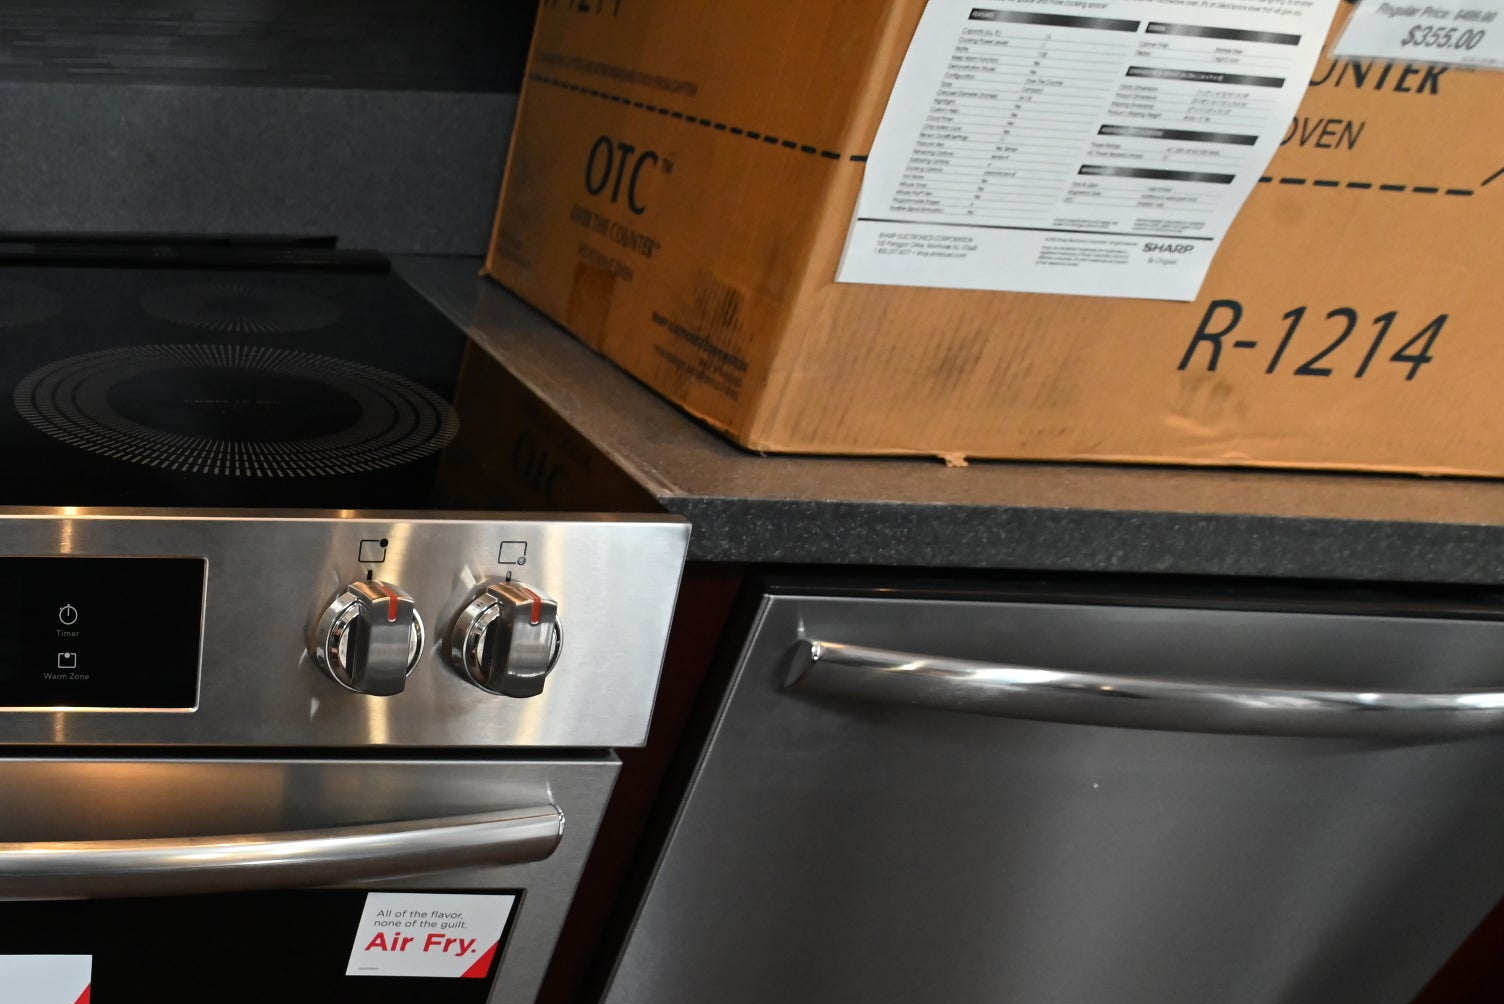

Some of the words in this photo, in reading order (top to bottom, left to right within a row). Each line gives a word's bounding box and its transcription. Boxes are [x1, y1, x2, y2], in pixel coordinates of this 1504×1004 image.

[1376, 2, 1419, 18] Regular
[1401, 24, 1486, 51] $355.00
[1142, 242, 1194, 254] SHARP
[1177, 298, 1450, 381] R-1214
[56, 629, 80, 637] Timer
[43, 672, 67, 680] Warm
[69, 672, 90, 680] Zone
[376, 910, 392, 918] All
[395, 910, 406, 918] of
[410, 910, 427, 919] the
[405, 920, 416, 928] of
[419, 920, 437, 928] the
[440, 921, 467, 929] guilt.
[365, 932, 414, 952] Air
[423, 933, 477, 956] Fry.
